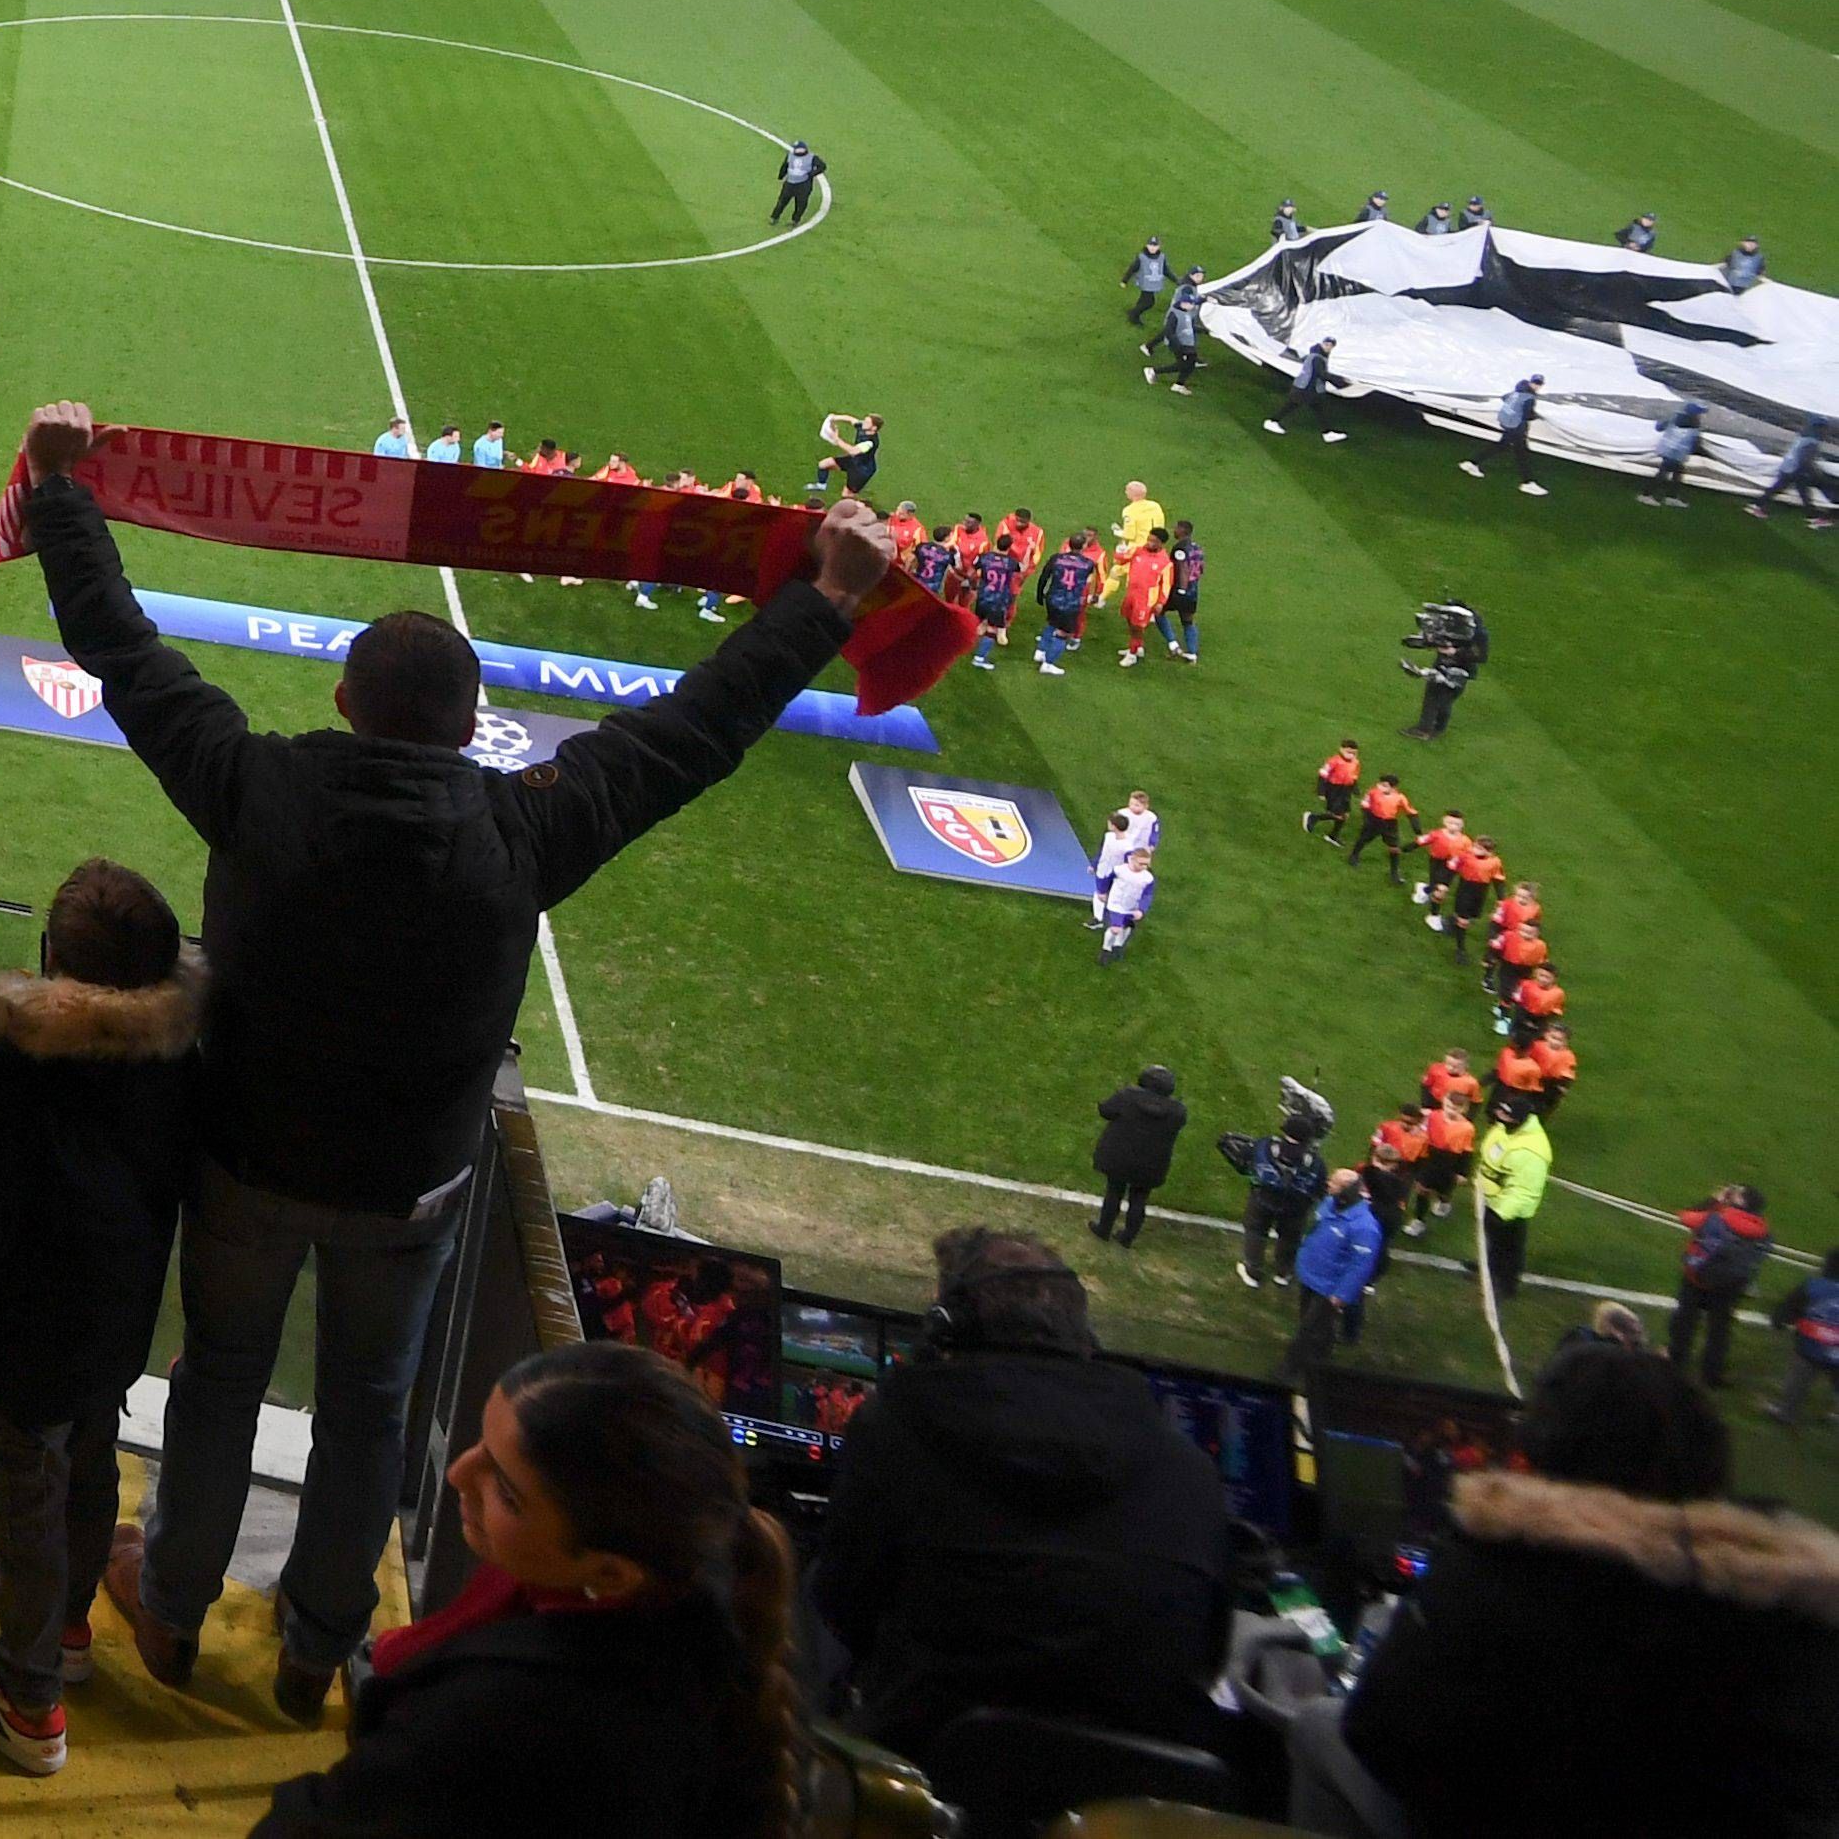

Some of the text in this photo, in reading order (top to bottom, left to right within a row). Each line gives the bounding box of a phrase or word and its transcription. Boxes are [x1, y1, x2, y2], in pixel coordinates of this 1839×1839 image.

[986, 569, 1007, 592] 21
[1061, 569, 1076, 591] 4
[540, 660, 677, 698] МИ
[928, 804, 996, 859] RCL
